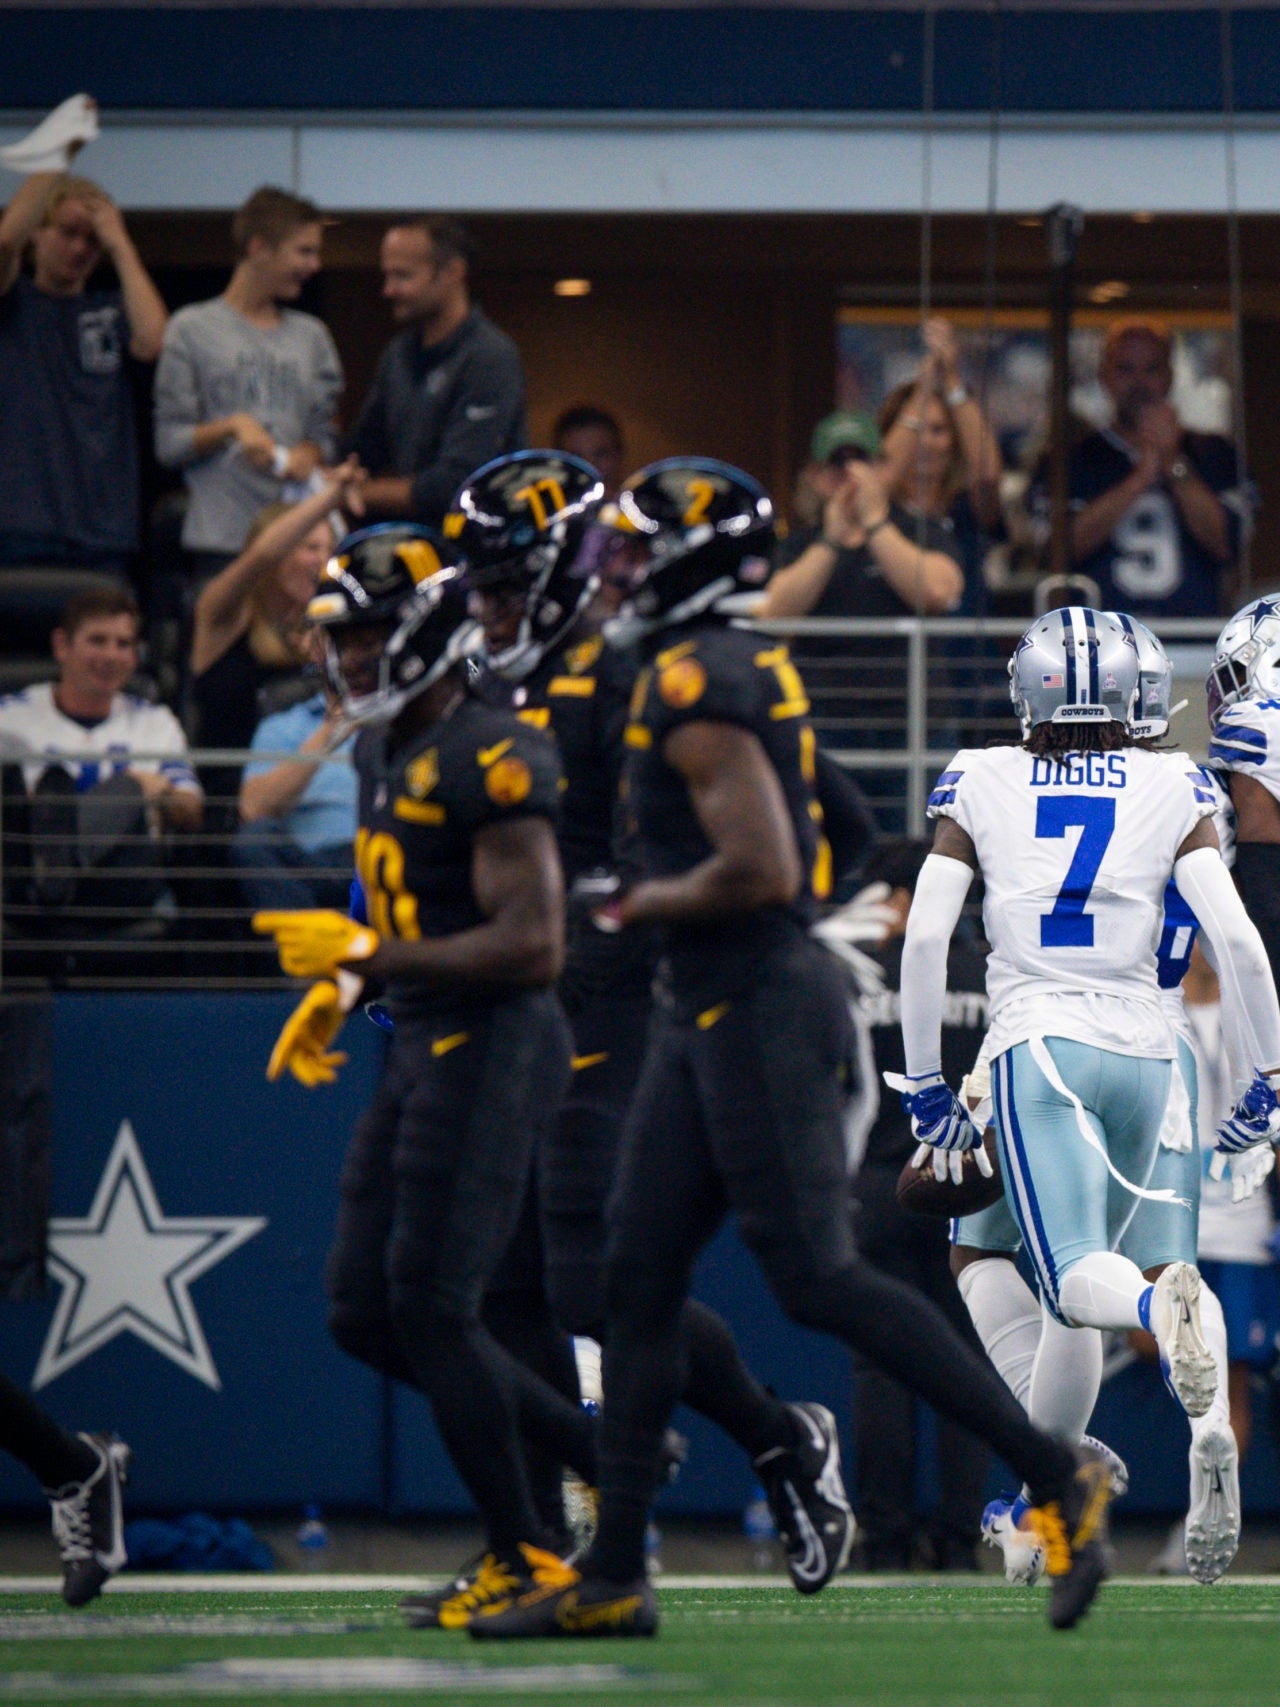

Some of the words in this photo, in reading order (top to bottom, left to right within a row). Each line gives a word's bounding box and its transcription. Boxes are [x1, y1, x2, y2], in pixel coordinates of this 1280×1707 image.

[682, 478, 713, 526] 2
[1112, 489, 1181, 599] 9
[1061, 706, 1105, 716] COWBOYS
[1129, 724, 1152, 736] BOYS
[1029, 751, 1127, 789] DIGGS
[1034, 794, 1117, 948] 7
